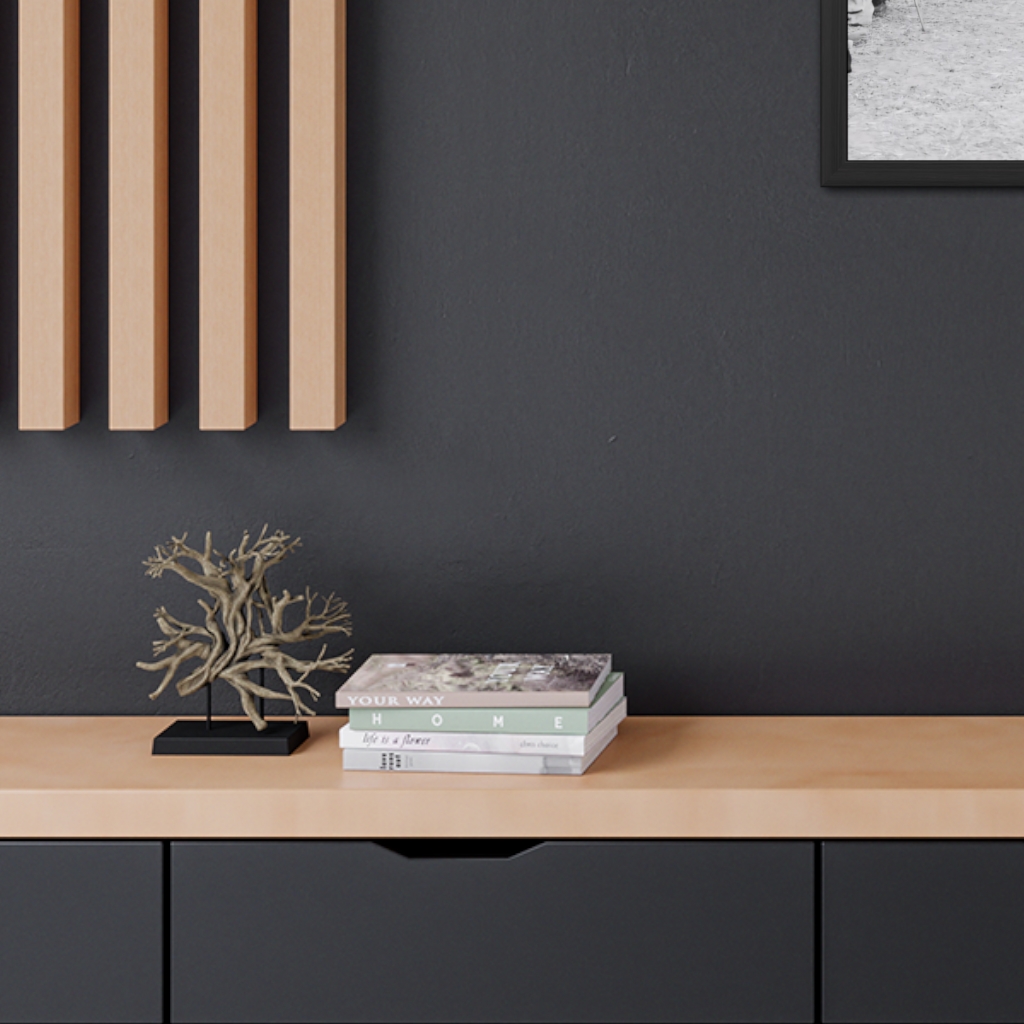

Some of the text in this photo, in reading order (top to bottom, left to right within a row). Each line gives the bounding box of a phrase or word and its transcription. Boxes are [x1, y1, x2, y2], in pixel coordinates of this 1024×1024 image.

[347, 696, 445, 706] YOUR WAY
[400, 733, 431, 748] flower
